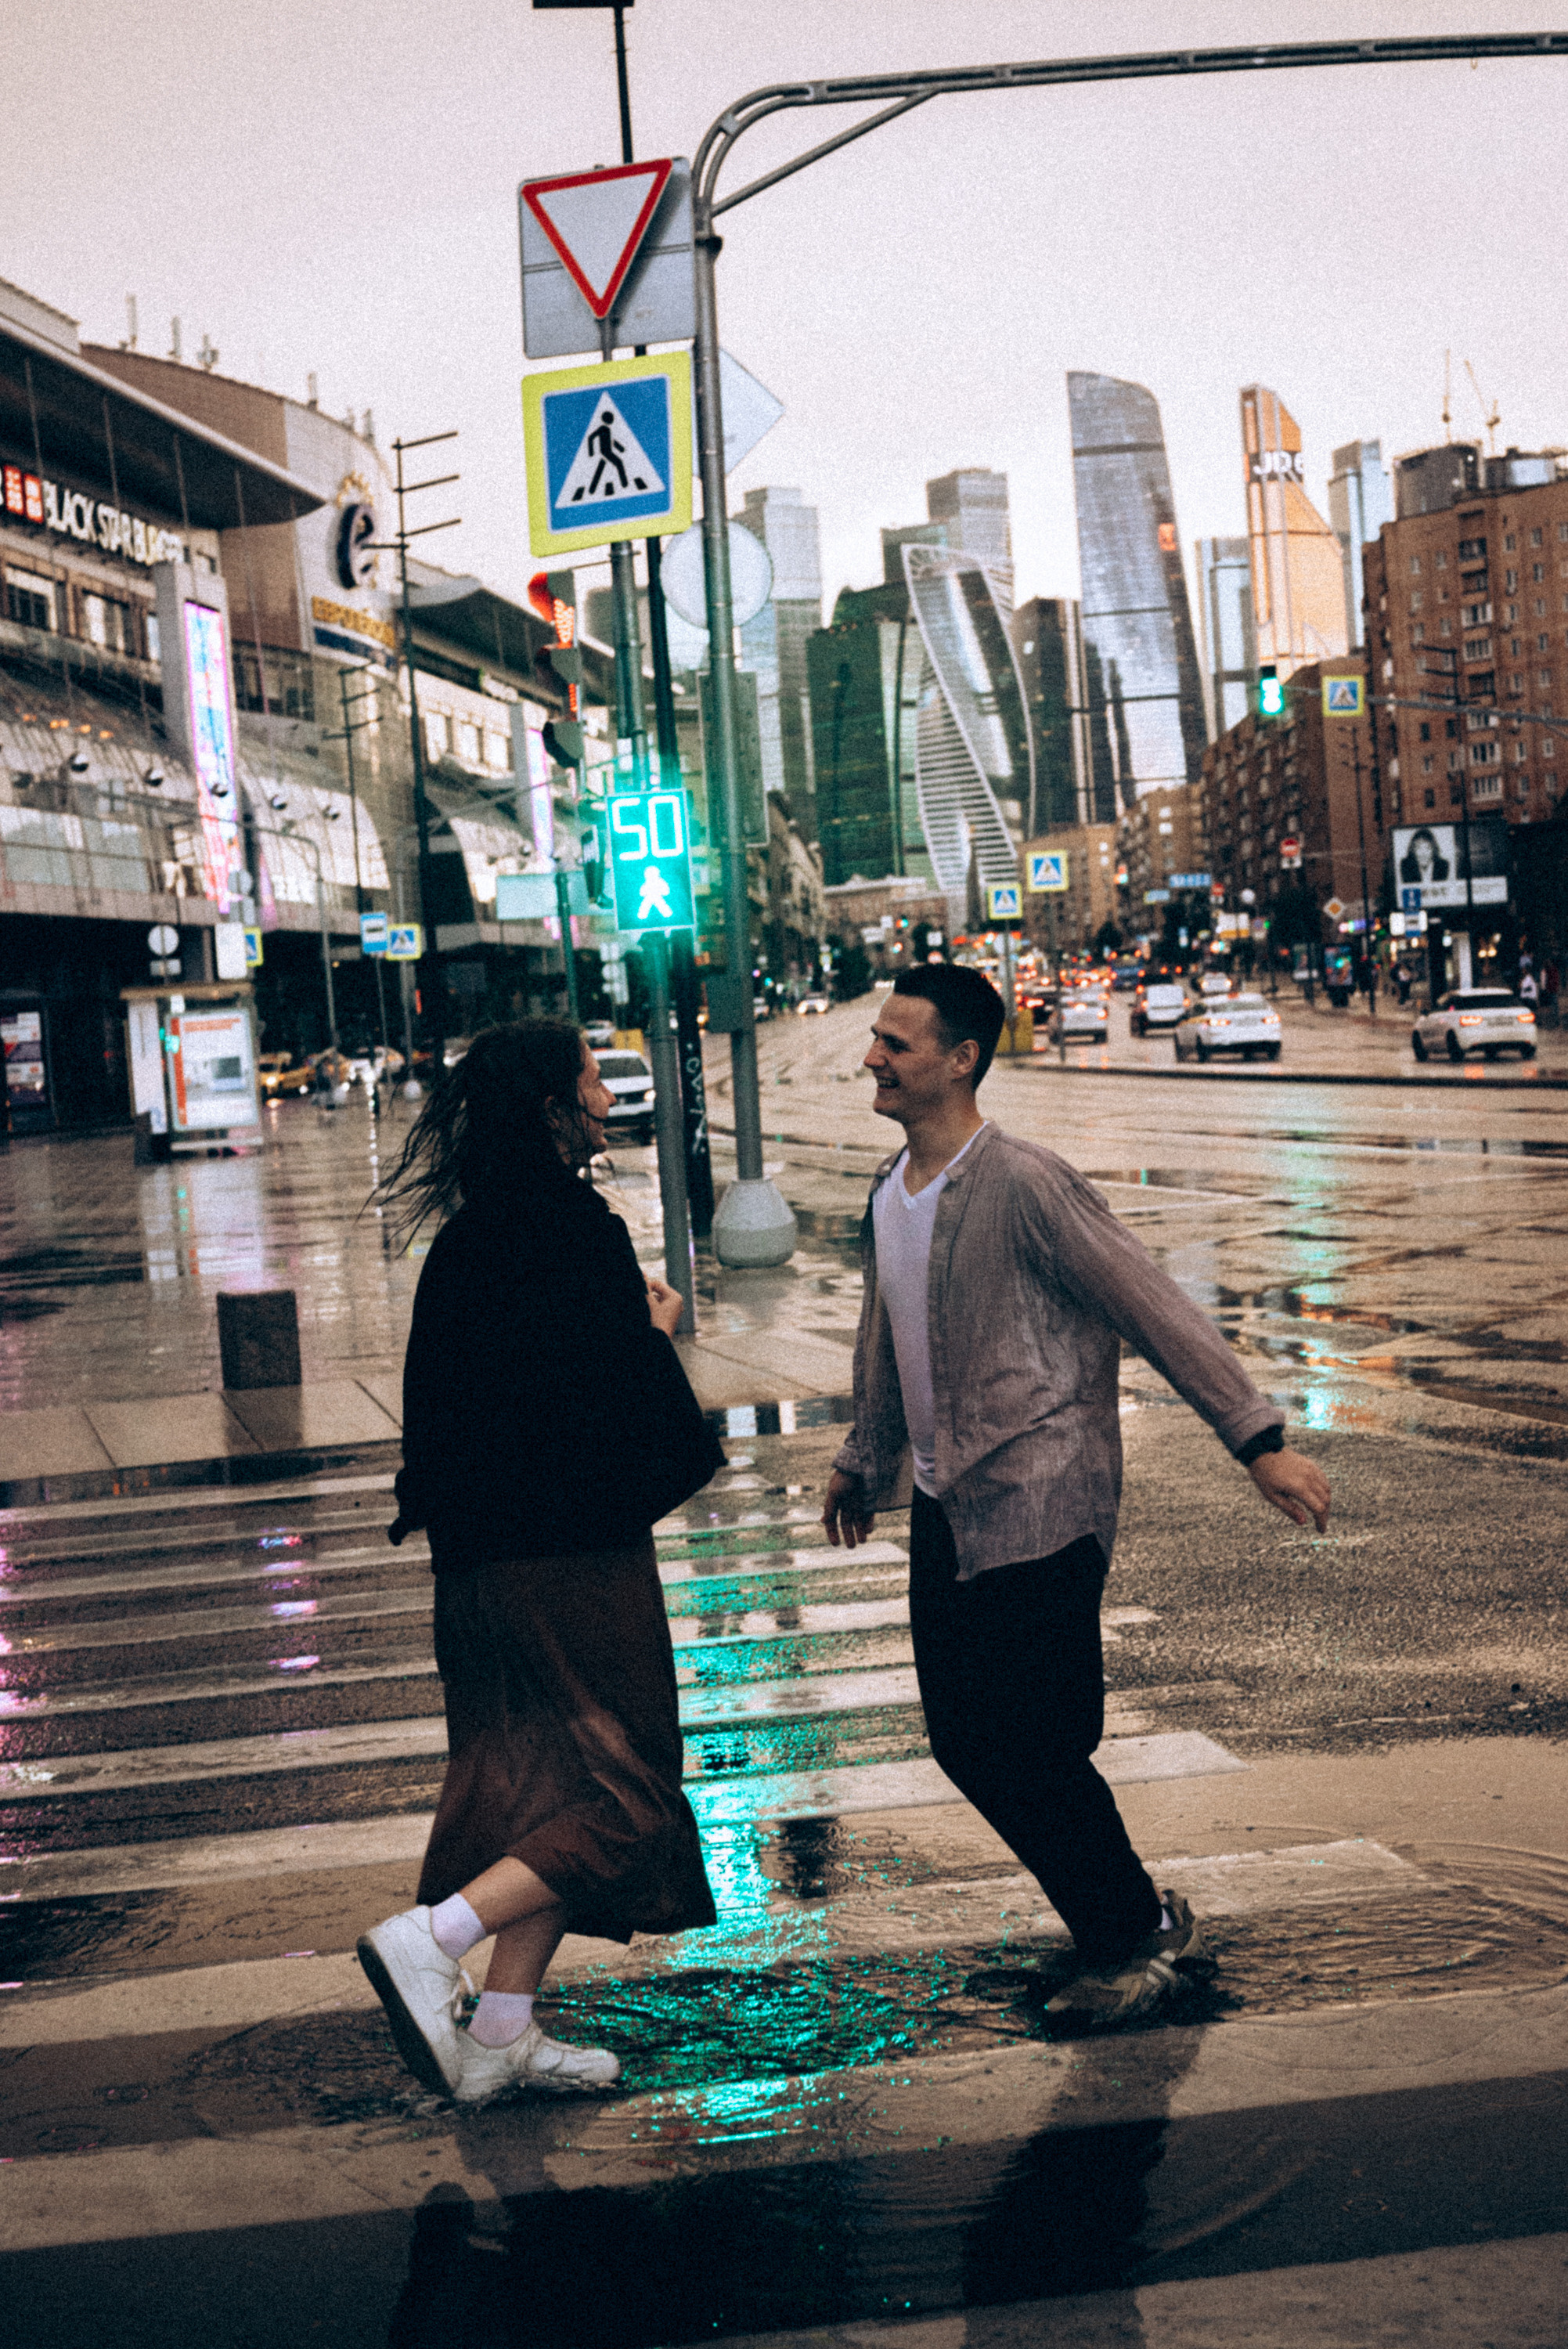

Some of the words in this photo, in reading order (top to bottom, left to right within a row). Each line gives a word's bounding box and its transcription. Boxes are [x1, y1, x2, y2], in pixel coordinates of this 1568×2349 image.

[42, 479, 98, 543] BLACK
[97, 503, 134, 558] STAR
[611, 795, 684, 861] 50
